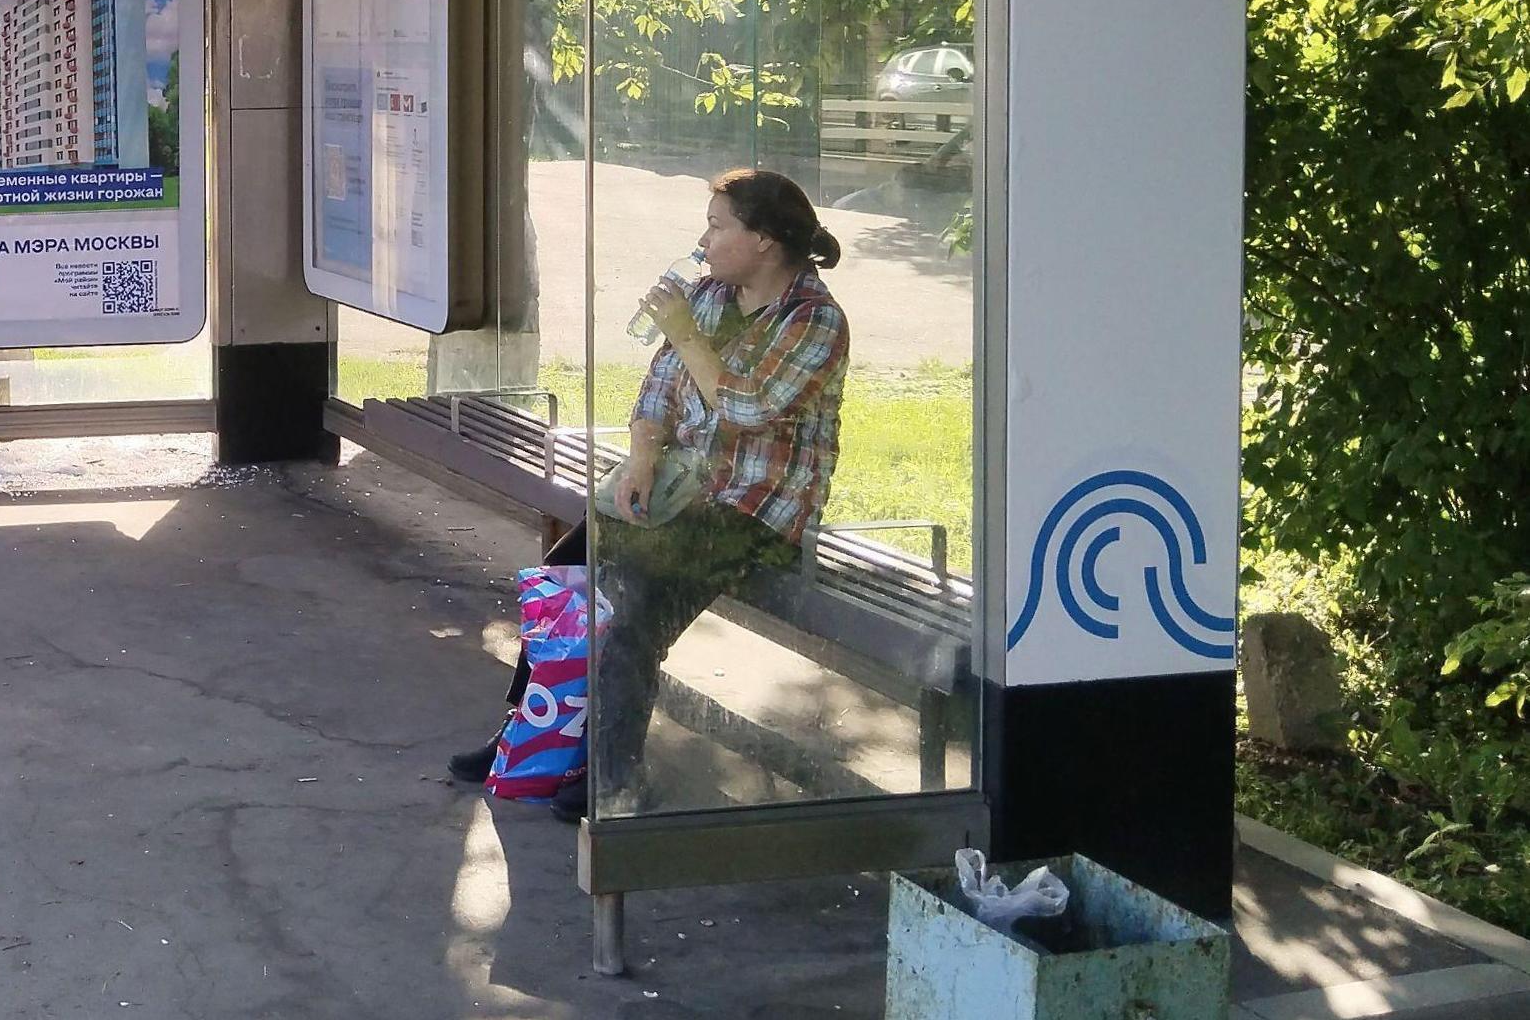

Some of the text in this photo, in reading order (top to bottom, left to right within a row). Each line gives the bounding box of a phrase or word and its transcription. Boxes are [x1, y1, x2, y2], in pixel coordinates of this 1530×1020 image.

[71, 172, 147, 186] квартиры
[44, 189, 94, 201] жизни
[98, 187, 163, 201] горожан
[14, 237, 70, 254] МЭРА
[74, 234, 159, 251] МОСКВЫ
